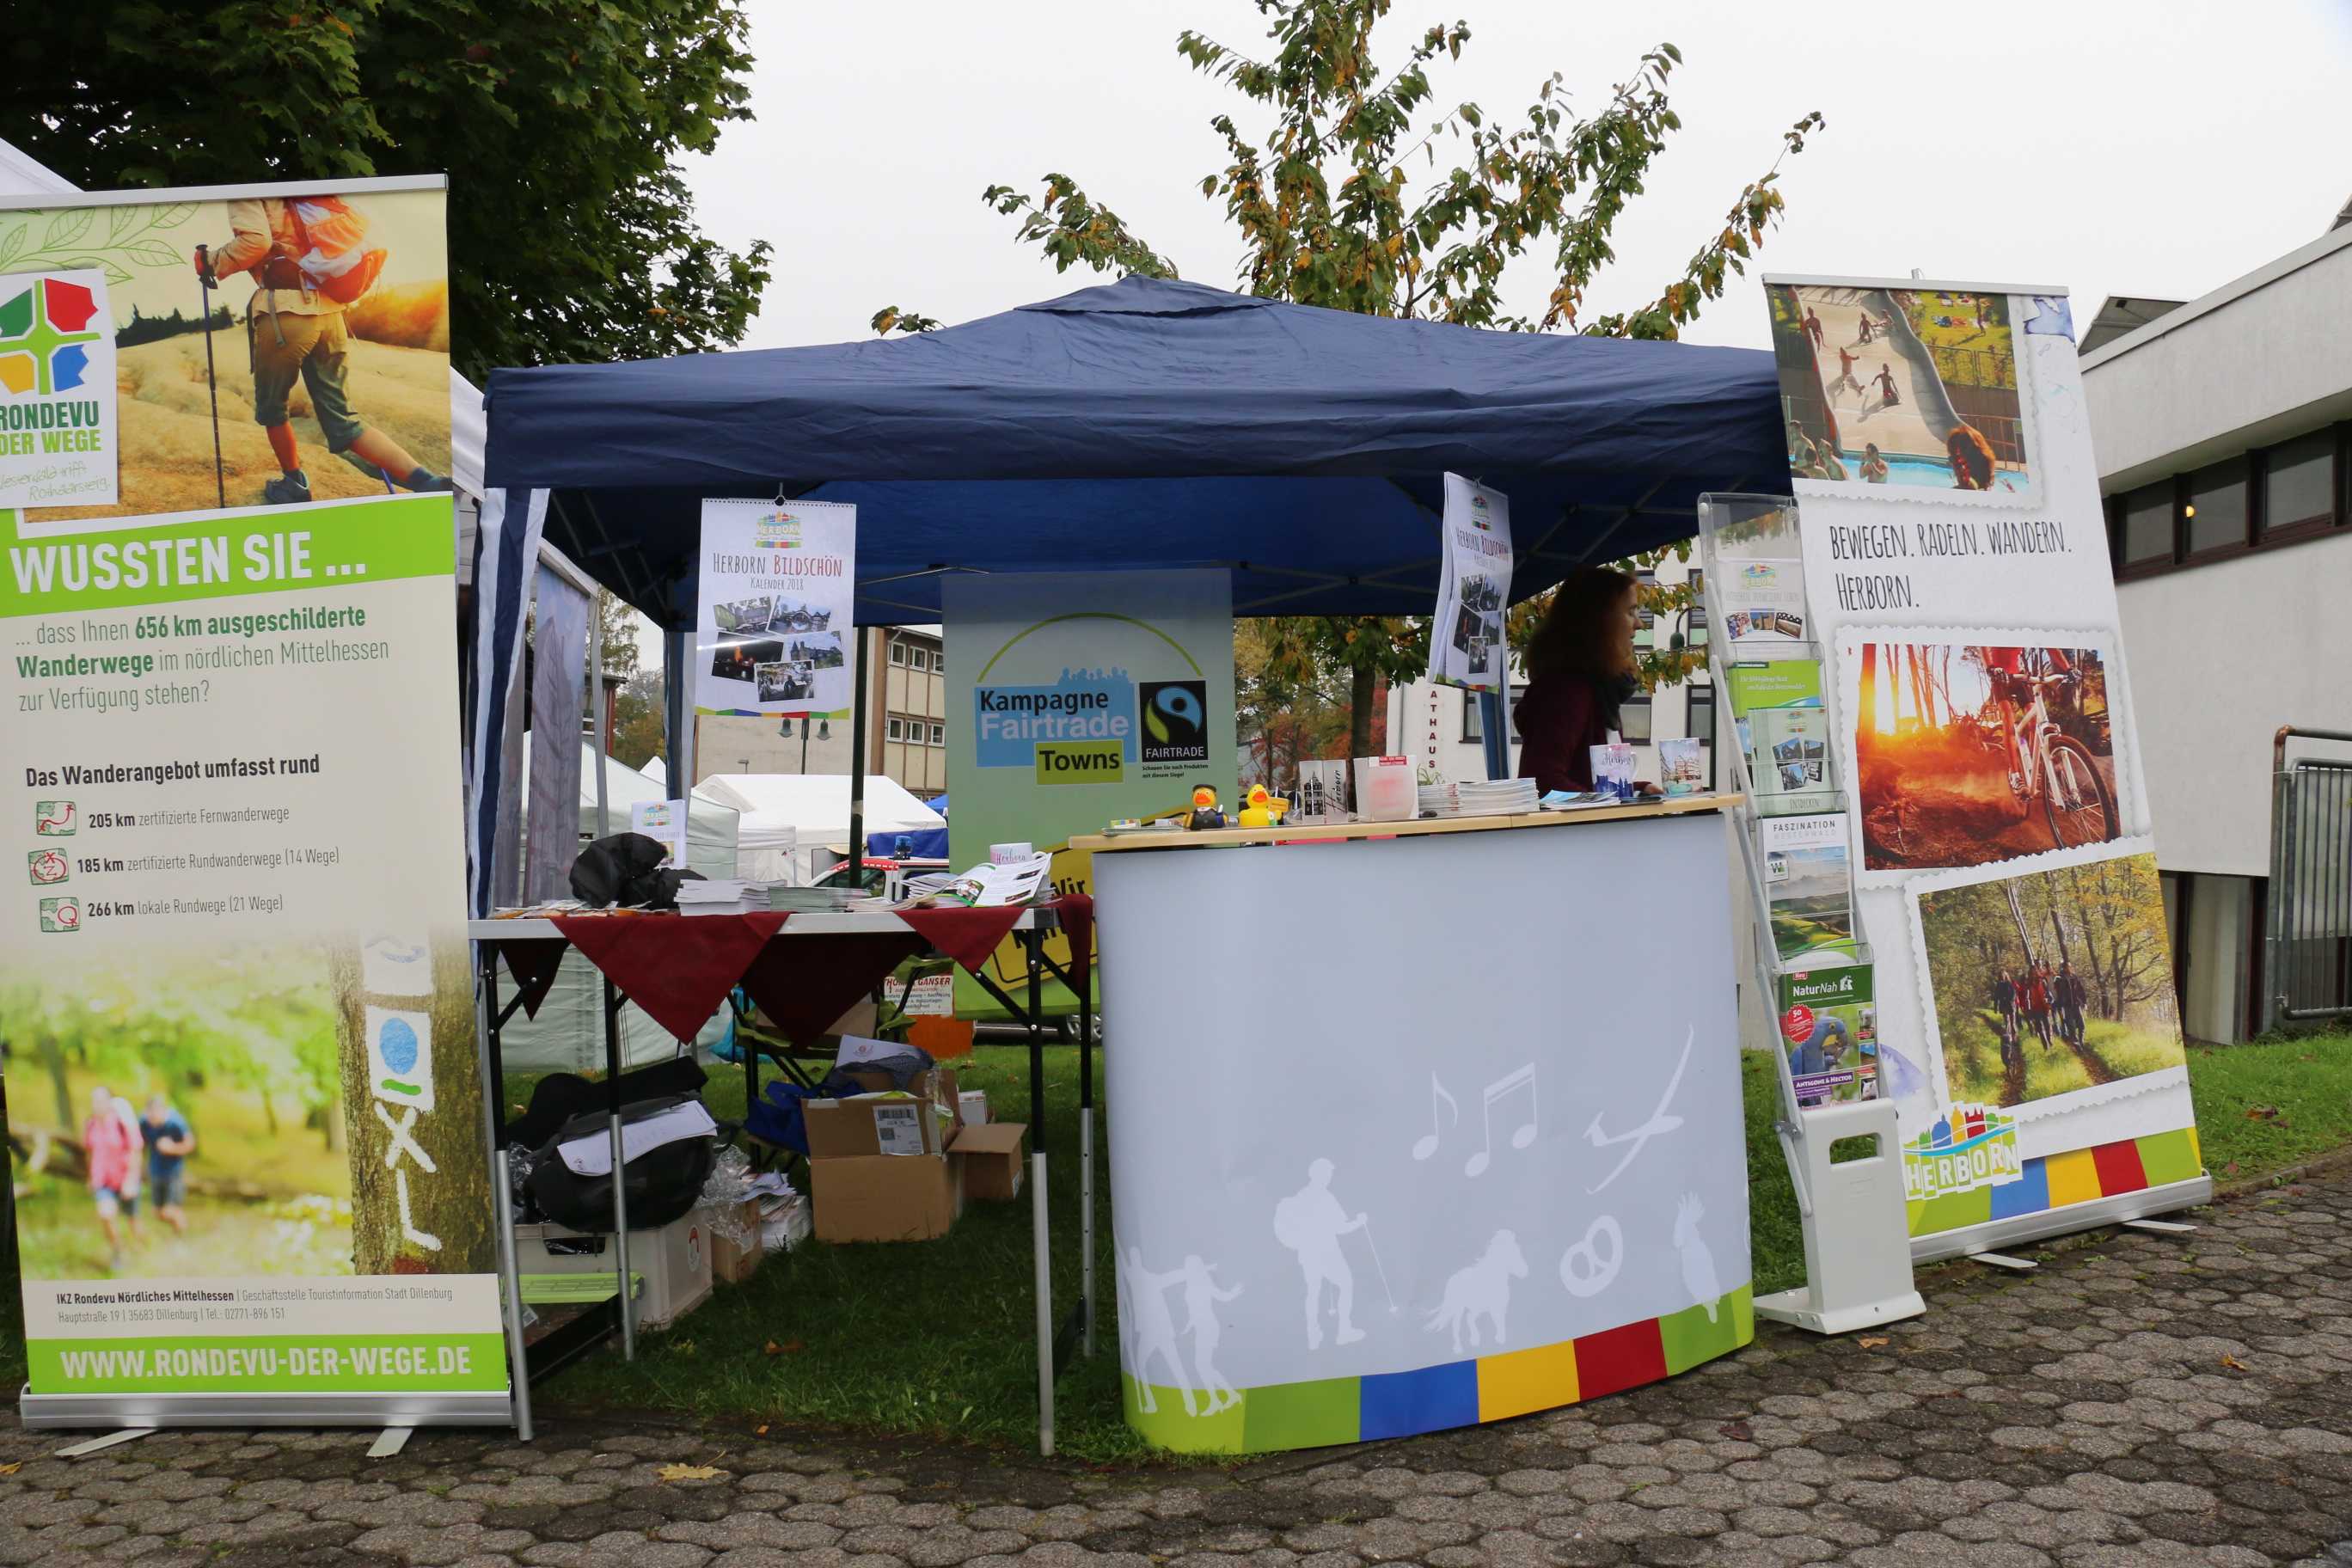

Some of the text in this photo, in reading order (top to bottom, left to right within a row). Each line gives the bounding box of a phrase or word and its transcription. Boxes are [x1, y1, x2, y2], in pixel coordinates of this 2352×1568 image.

[0, 401, 100, 432] RONDEVU
[0, 429, 102, 456] DER WEGE
[0, 465, 58, 490] esterwald
[756, 524, 801, 535] HERBORN
[1829, 521, 2072, 560] BEWEGEN. RADELN. WANDERN.
[9, 535, 230, 594] WUSSTEN
[243, 530, 313, 580] SIE
[787, 579, 804, 591] 2018
[1834, 573, 1920, 611] HERBORN.
[36, 622, 77, 645] dass
[82, 618, 130, 643] Ihnen
[134, 615, 169, 640] 656
[174, 614, 203, 639] km
[207, 605, 367, 638] ausgeschilderte
[16, 639, 389, 679] Wanderwege im nördlichen Mittelhessen
[19, 679, 211, 714] zur Verfügung stehen?
[980, 690, 1109, 715] Kampagne
[981, 710, 1130, 740] Fairtrade
[1428, 689, 1438, 769] ATHAUS
[1038, 750, 1121, 772] Towns
[1145, 745, 1205, 758] FAIRTRADE
[25, 753, 321, 787] Das Wanderangebot umfasst rund
[89, 805, 291, 830] 205 km zertifizierte Fernwanderwege
[1773, 819, 1836, 832] FASZINATION
[1773, 829, 1836, 840] WESTERWALD
[77, 846, 340, 873] 185 km zertifizierte Rundwanderwege (14 Wege)
[88, 893, 284, 918] 266 km lokale Rundwege (21 Wege)
[917, 977, 951, 986] GANSER
[1792, 981, 1838, 997] NaturNah
[1792, 1009, 1803, 1019] 50
[1796, 1078, 1825, 1088] ANTIGONE
[1830, 1075, 1853, 1083] HECTOR
[1905, 1142, 2019, 1192] HERBORN
[57, 1287, 453, 1305] IKZ Rondevu Nördliches Mittelhessen Geschäftsstelle Touristinformation Stadt Dillenburg
[58, 1310, 107, 1325] Hauptstraße
[110, 1309, 120, 1322] 19
[128, 1308, 155, 1321] 35683
[156, 1308, 199, 1323] Dillenburg
[224, 1307, 268, 1320] 02771-896
[271, 1307, 285, 1320] 151
[59, 1345, 472, 1379] WWW.RONDEVU-DER-WEGE.DE
